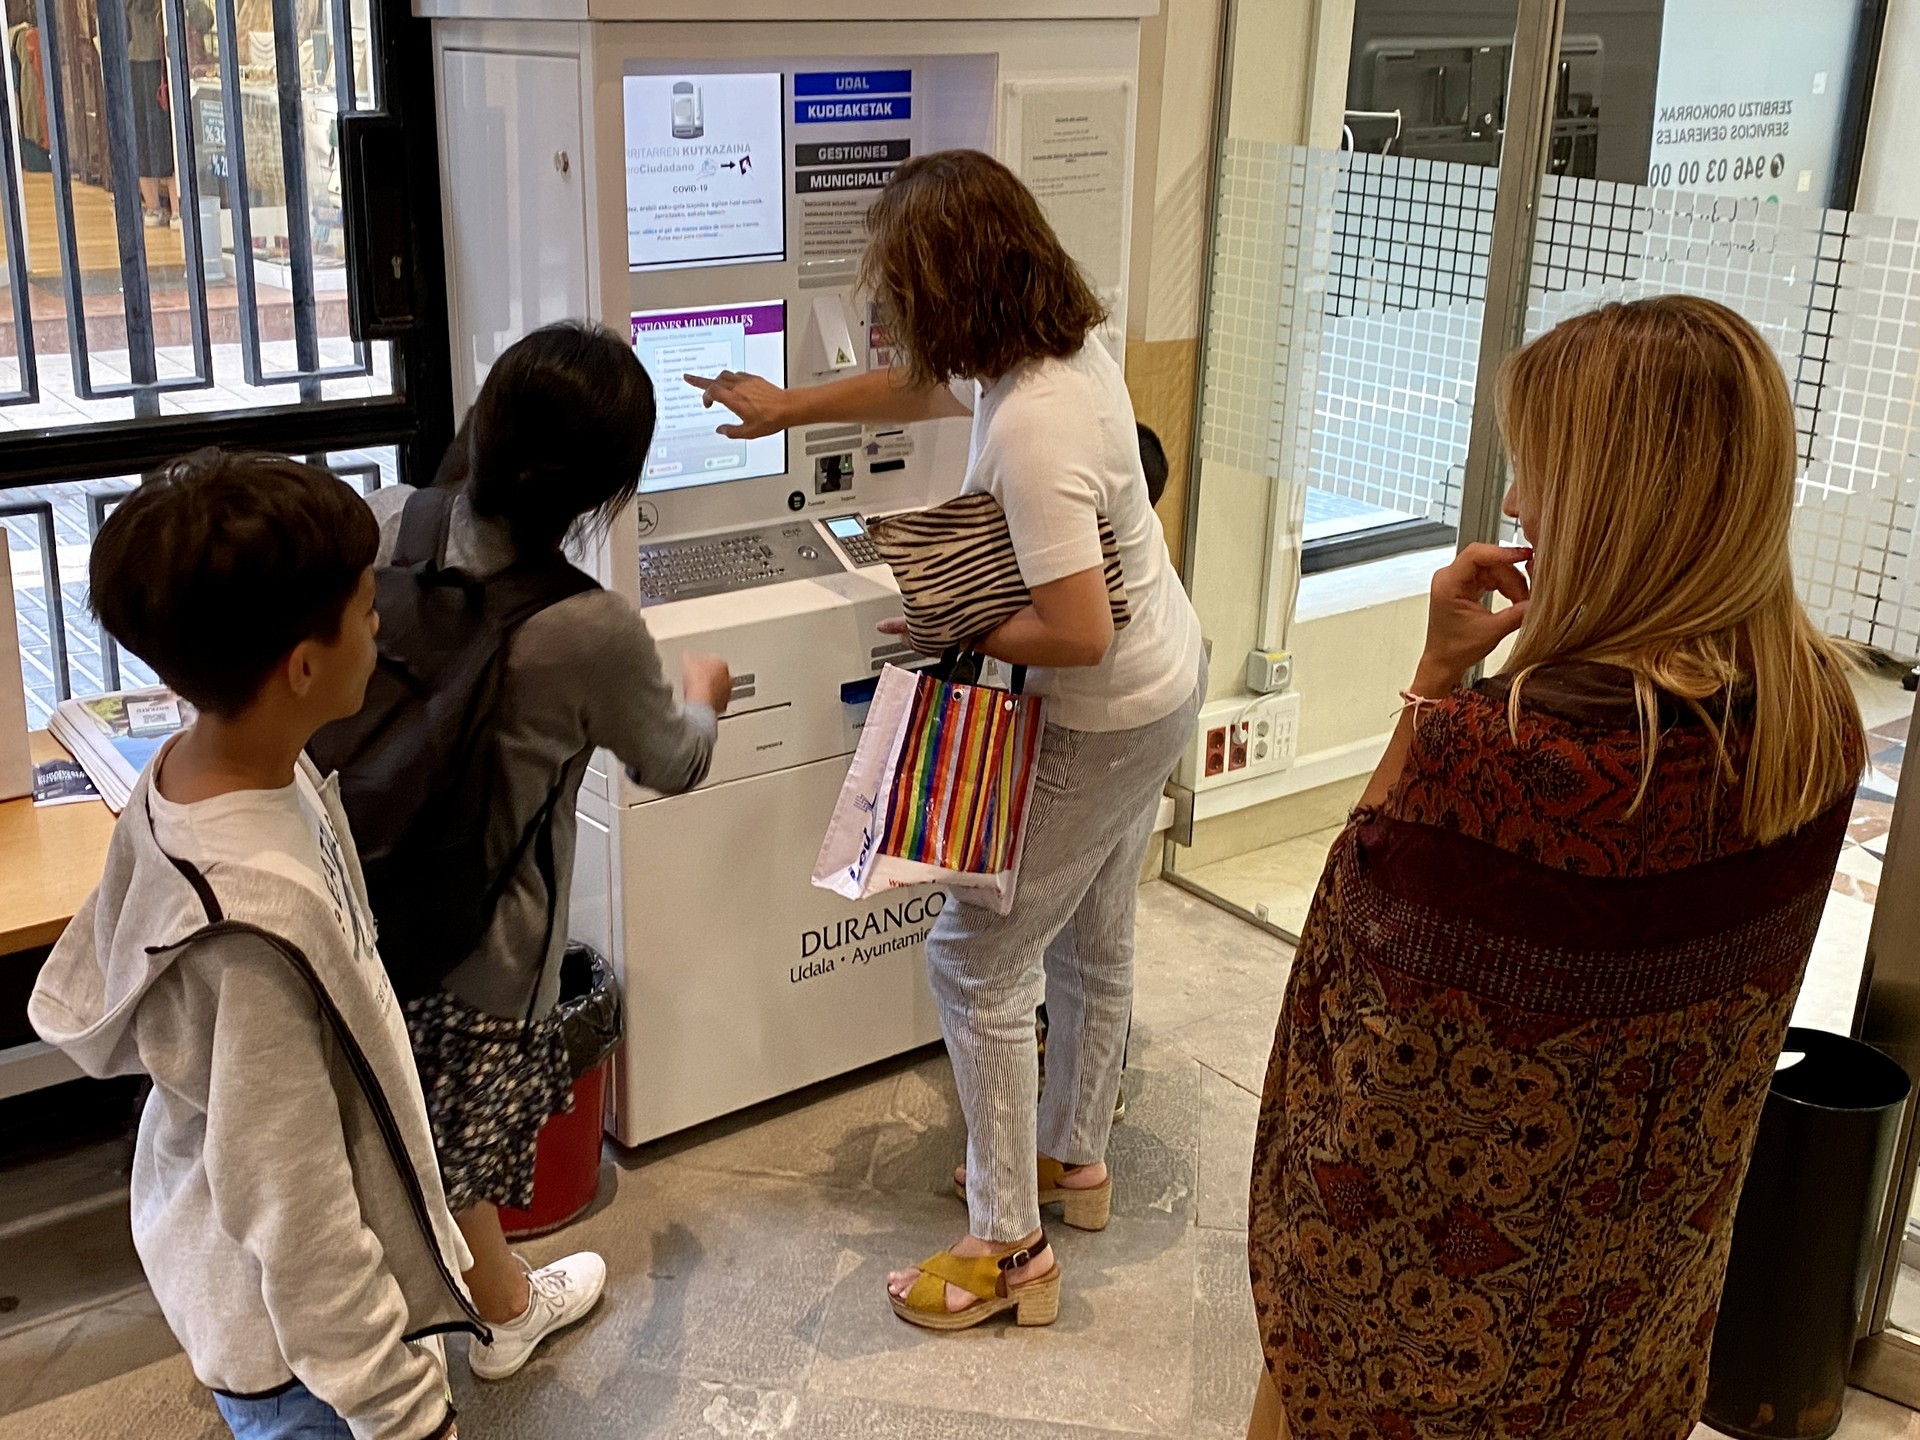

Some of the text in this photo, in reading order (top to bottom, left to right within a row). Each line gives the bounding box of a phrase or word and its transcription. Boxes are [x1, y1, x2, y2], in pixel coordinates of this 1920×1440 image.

[835, 76, 870, 91] UDAL
[807, 102, 893, 119] KUDEAKETAK
[682, 143, 751, 156] KUTXAZAINA
[818, 145, 888, 160] GESTIONES
[672, 184, 708, 193] COVID-19
[800, 890, 947, 959] DURANGO
[789, 957, 835, 984] Udala
